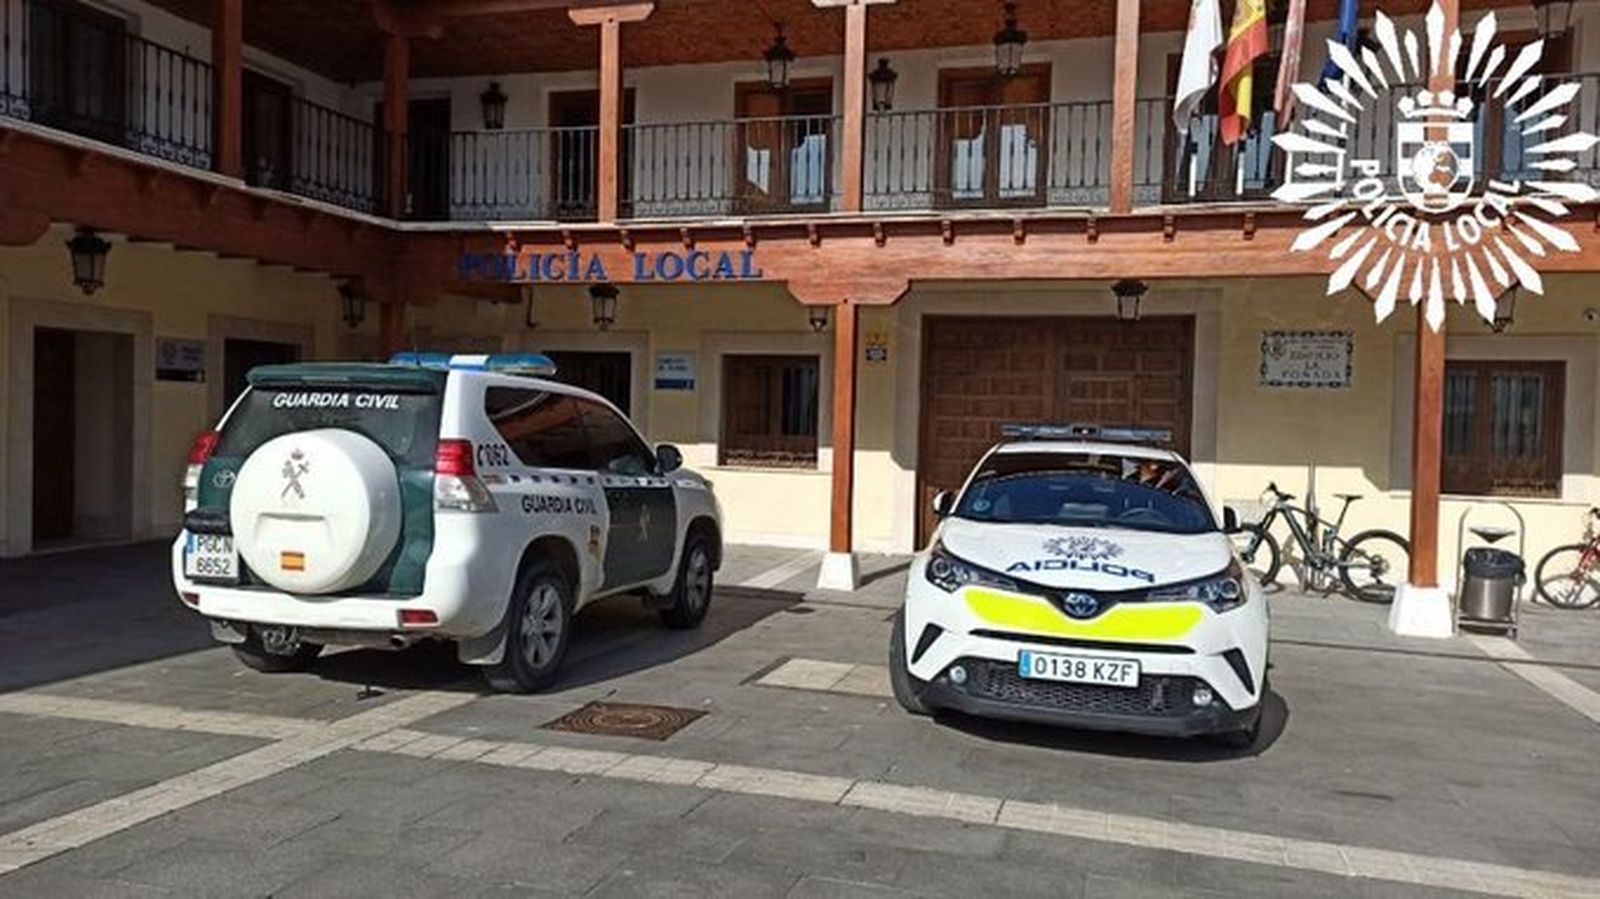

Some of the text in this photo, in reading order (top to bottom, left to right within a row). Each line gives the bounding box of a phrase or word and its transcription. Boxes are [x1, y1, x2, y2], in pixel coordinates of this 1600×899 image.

[634, 250, 763, 281] LOCAL
[273, 392, 400, 409] GUARDIA CIVIL
[521, 494, 573, 514] GUARDIA
[197, 534, 233, 553] PGCN
[197, 557, 231, 575] 6652
[1034, 656, 1134, 683] 0138 KZF
